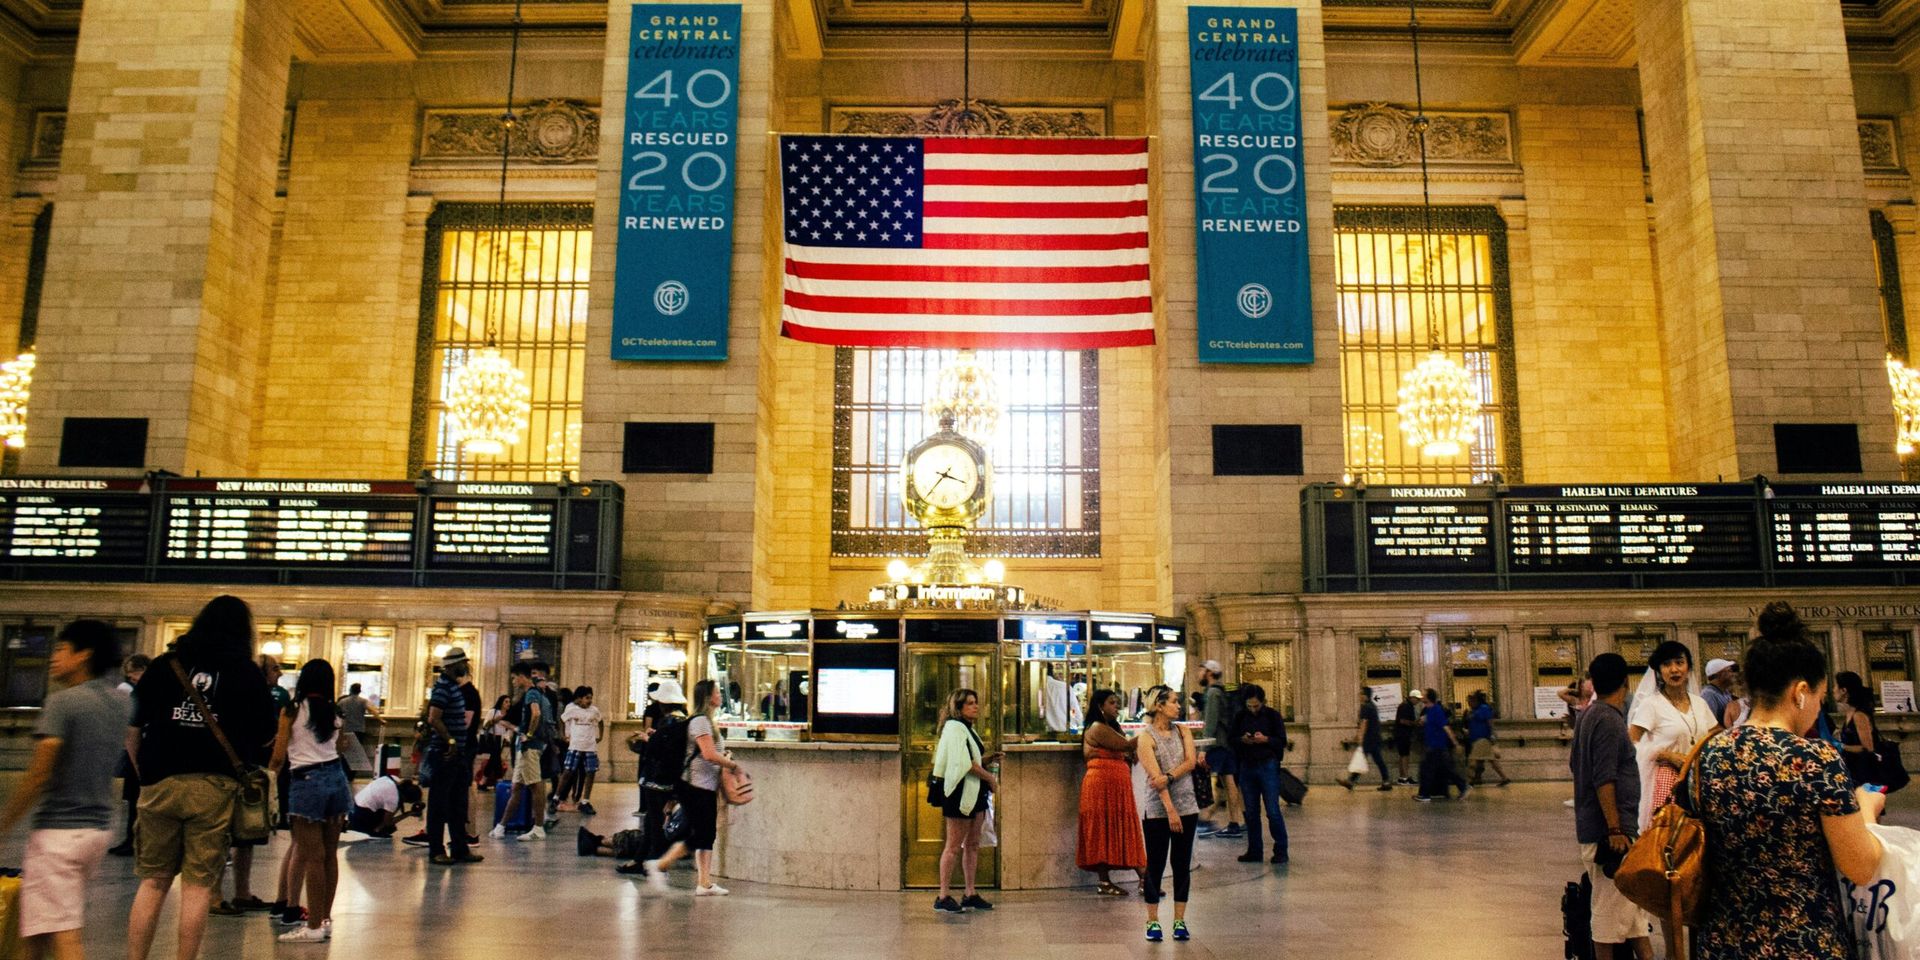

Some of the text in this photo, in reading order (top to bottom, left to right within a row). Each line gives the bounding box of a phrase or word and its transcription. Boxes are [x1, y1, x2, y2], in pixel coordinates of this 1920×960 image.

[650, 16, 719, 26] GRAND
[1208, 18, 1276, 29] GRAND
[640, 30, 732, 40] CENTRAL
[1198, 32, 1290, 43] CENTRAL
[634, 38, 736, 60] celebrates
[1194, 40, 1295, 63] celebrates
[634, 69, 731, 108] 40
[1199, 72, 1294, 111] 40
[633, 111, 728, 129] YEARS
[1199, 114, 1295, 132] YEARS
[630, 132, 728, 145] RESCUED
[1200, 135, 1296, 148] RESCUED
[628, 151, 727, 191] 20
[1202, 154, 1296, 194] 20
[630, 194, 726, 213] YEARS
[1203, 197, 1300, 216] YEARS
[625, 217, 725, 230] RENEWED
[1202, 220, 1300, 233] RENEWED
[622, 338, 716, 347] GCTcelebrates.com
[1209, 340, 1304, 350] GCTcelebrates.com
[20, 480, 42, 488] LINE
[45, 480, 107, 489] DEPARTURES
[217, 482, 370, 492] NEW HAVEN LINE DEPARTURES
[458, 484, 532, 494] INFORMATION
[1822, 486, 1865, 494] HARLEM
[1867, 486, 1890, 494] LINE
[1391, 488, 1466, 498] INFORMATION
[1562, 487, 1698, 496] HARLEM LINE DEPARTURES
[918, 585, 994, 600] Information
[172, 707, 219, 722] BEASS
